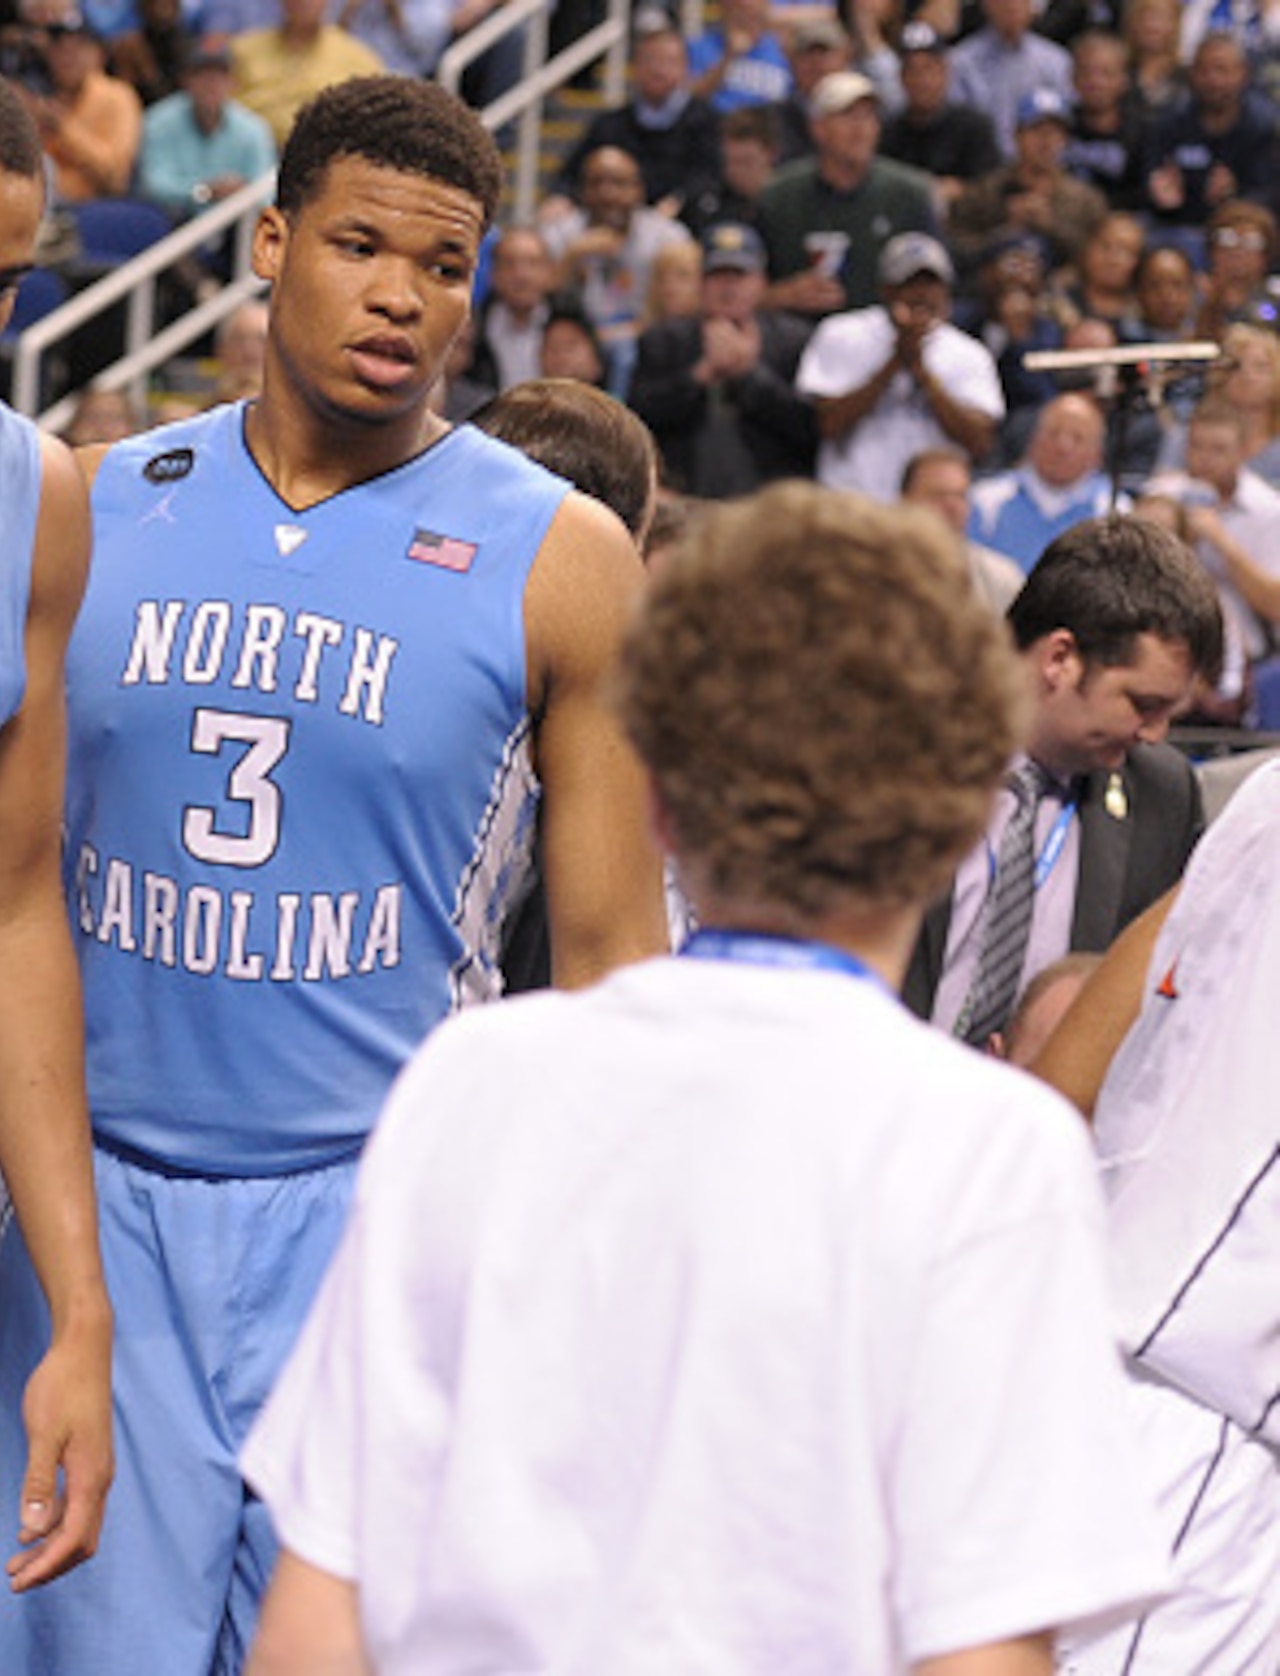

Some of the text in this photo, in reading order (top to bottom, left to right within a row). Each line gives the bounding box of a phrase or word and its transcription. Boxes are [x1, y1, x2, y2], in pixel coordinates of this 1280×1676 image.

[119, 599, 398, 726] NORTH
[182, 706, 292, 869] 3
[76, 842, 402, 982] CAROLINA
